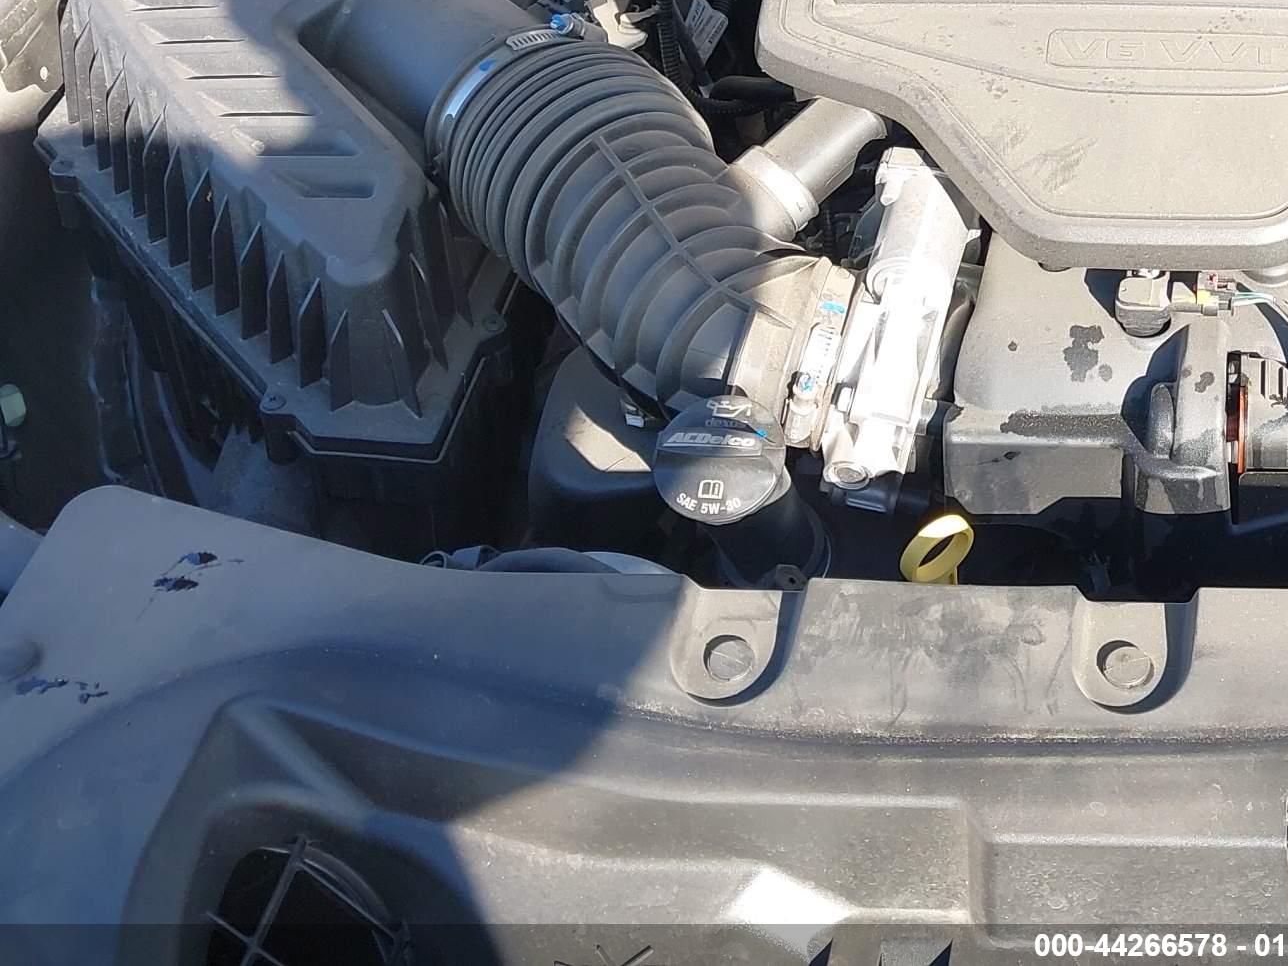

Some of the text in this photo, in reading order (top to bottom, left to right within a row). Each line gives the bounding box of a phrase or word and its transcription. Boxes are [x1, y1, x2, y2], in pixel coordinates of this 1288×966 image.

[1060, 38, 1287, 65] V6 VVT
[667, 432, 756, 447] ACDelco
[676, 492, 741, 515] SAE 5W-30
